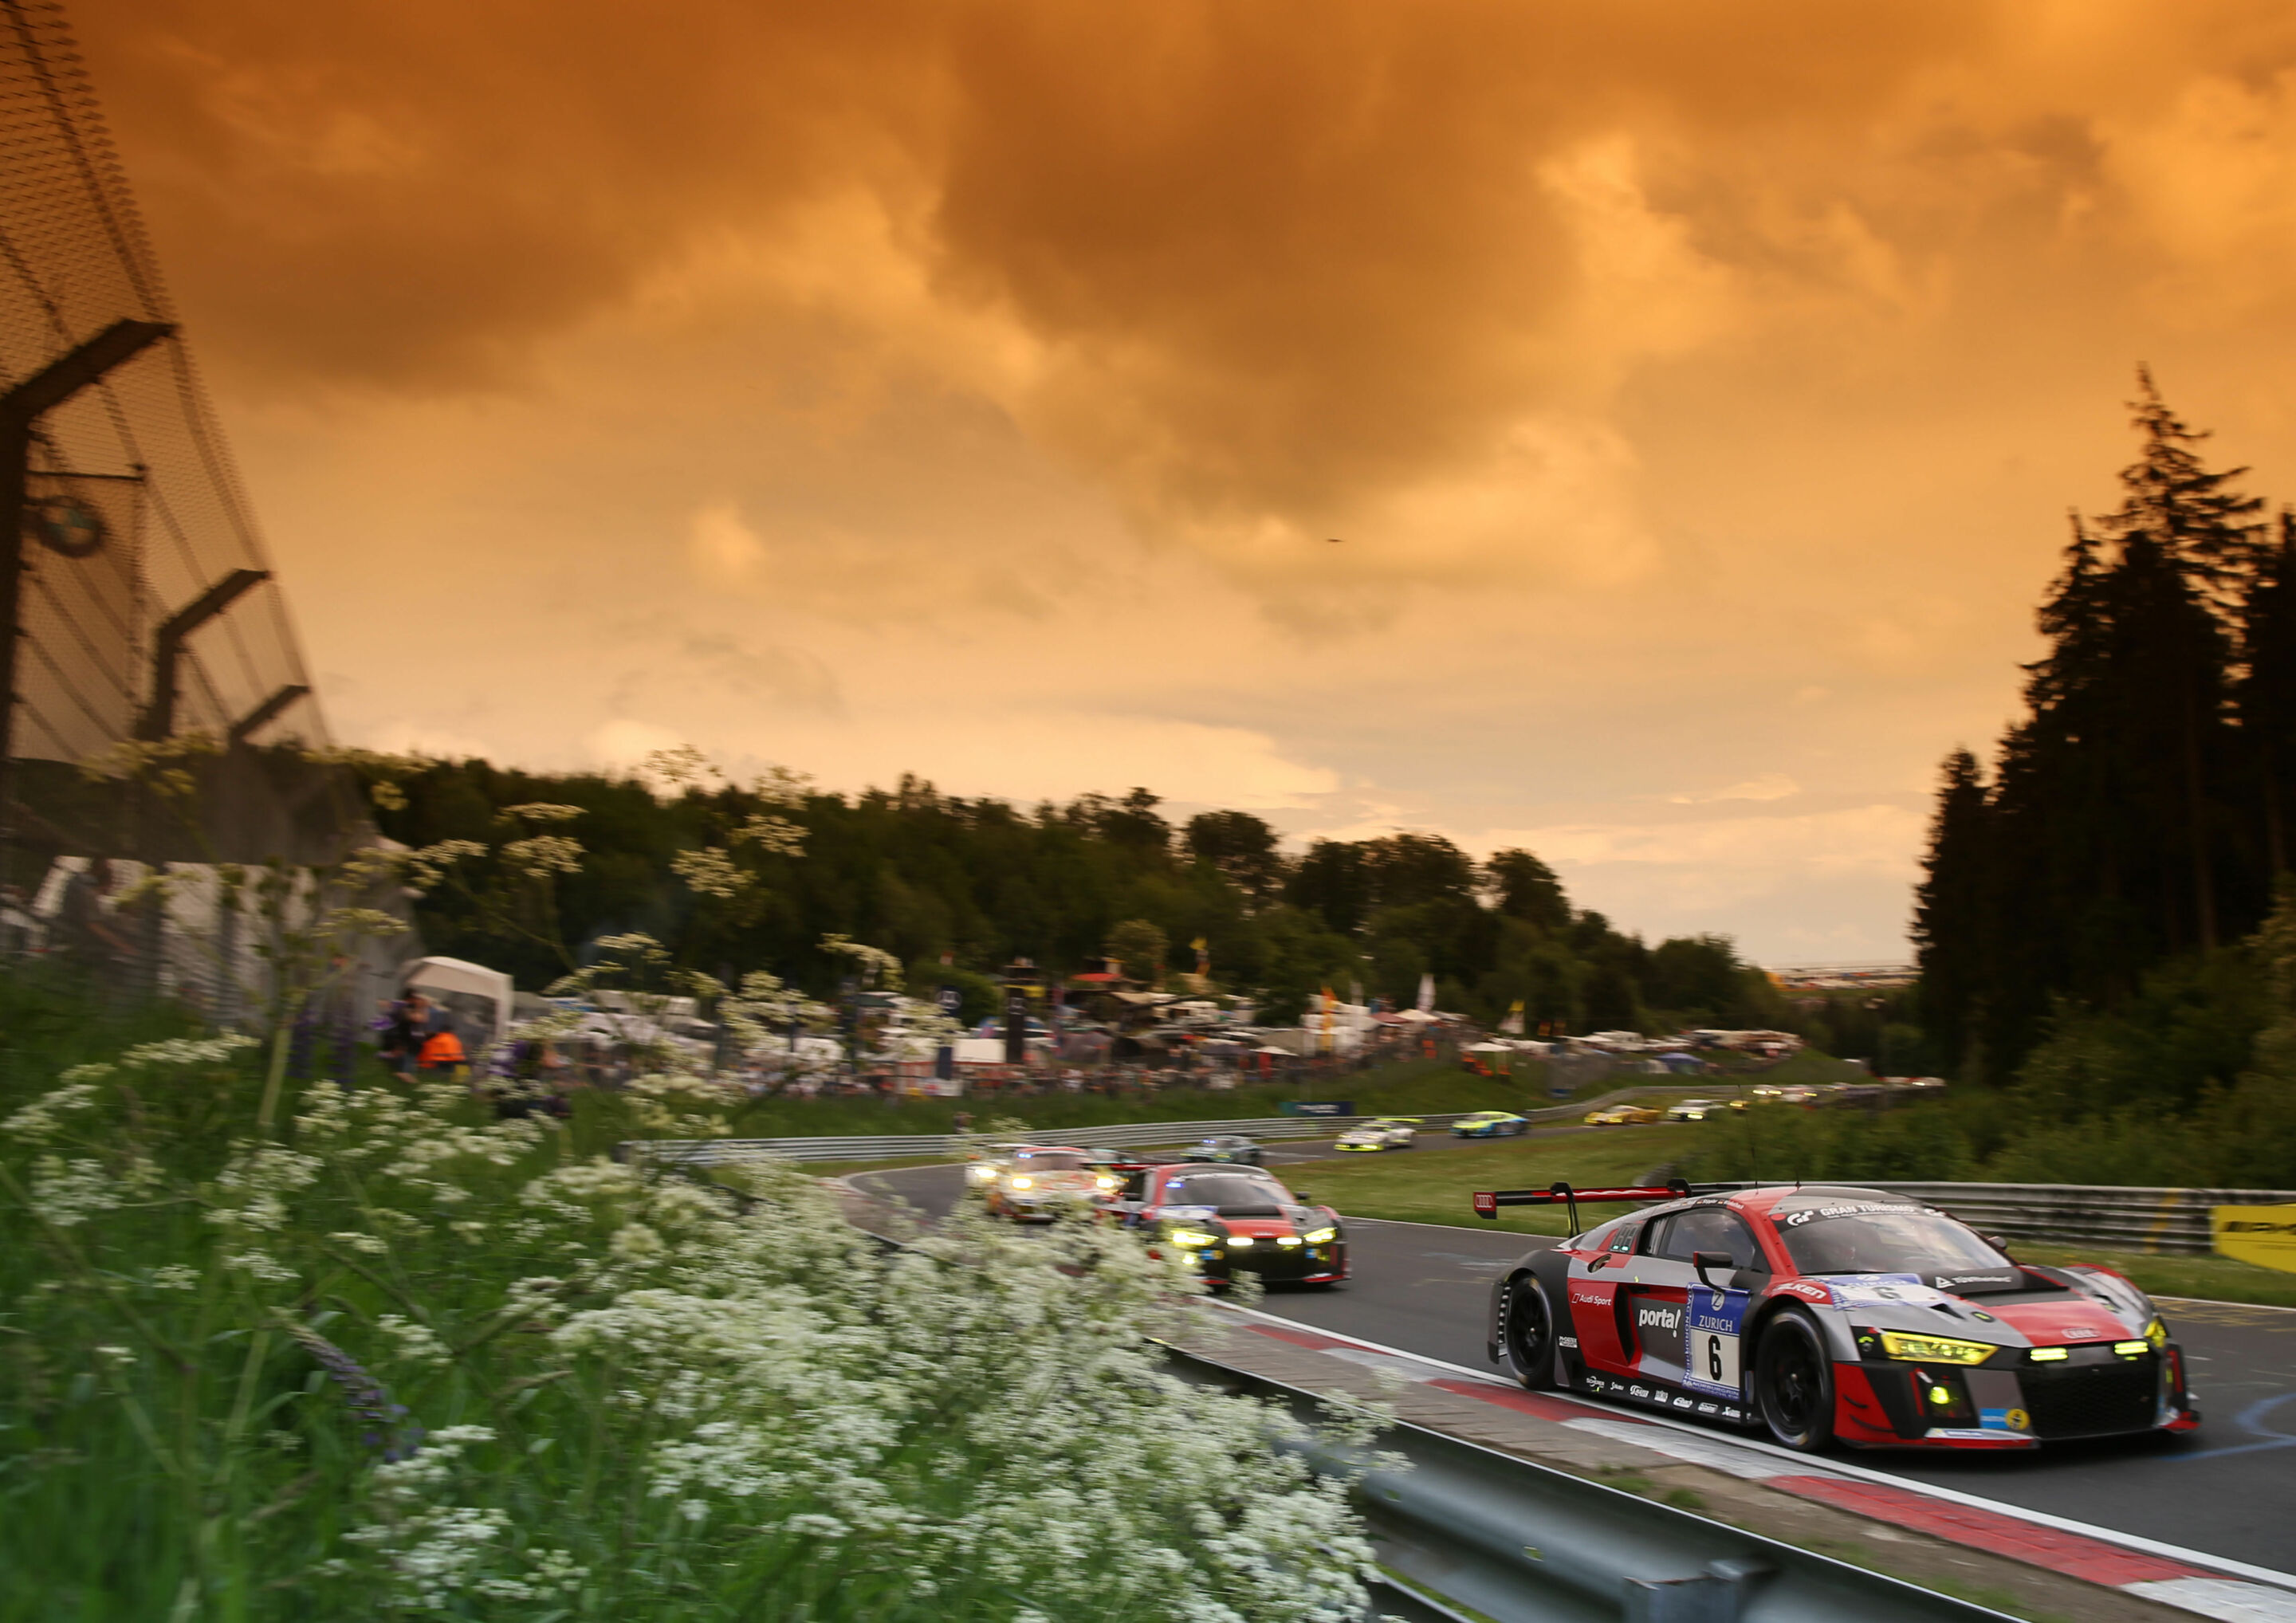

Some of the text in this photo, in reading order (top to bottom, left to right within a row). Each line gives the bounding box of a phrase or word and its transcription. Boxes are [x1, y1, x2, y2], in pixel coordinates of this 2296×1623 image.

[1820, 1205, 1858, 1216] GRAN
[1579, 1295, 1612, 1307] Audi Sport
[1638, 1308, 1681, 1338] porta!
[1699, 1315, 1733, 1332] ZURICH
[1708, 1334, 1722, 1381] 6
